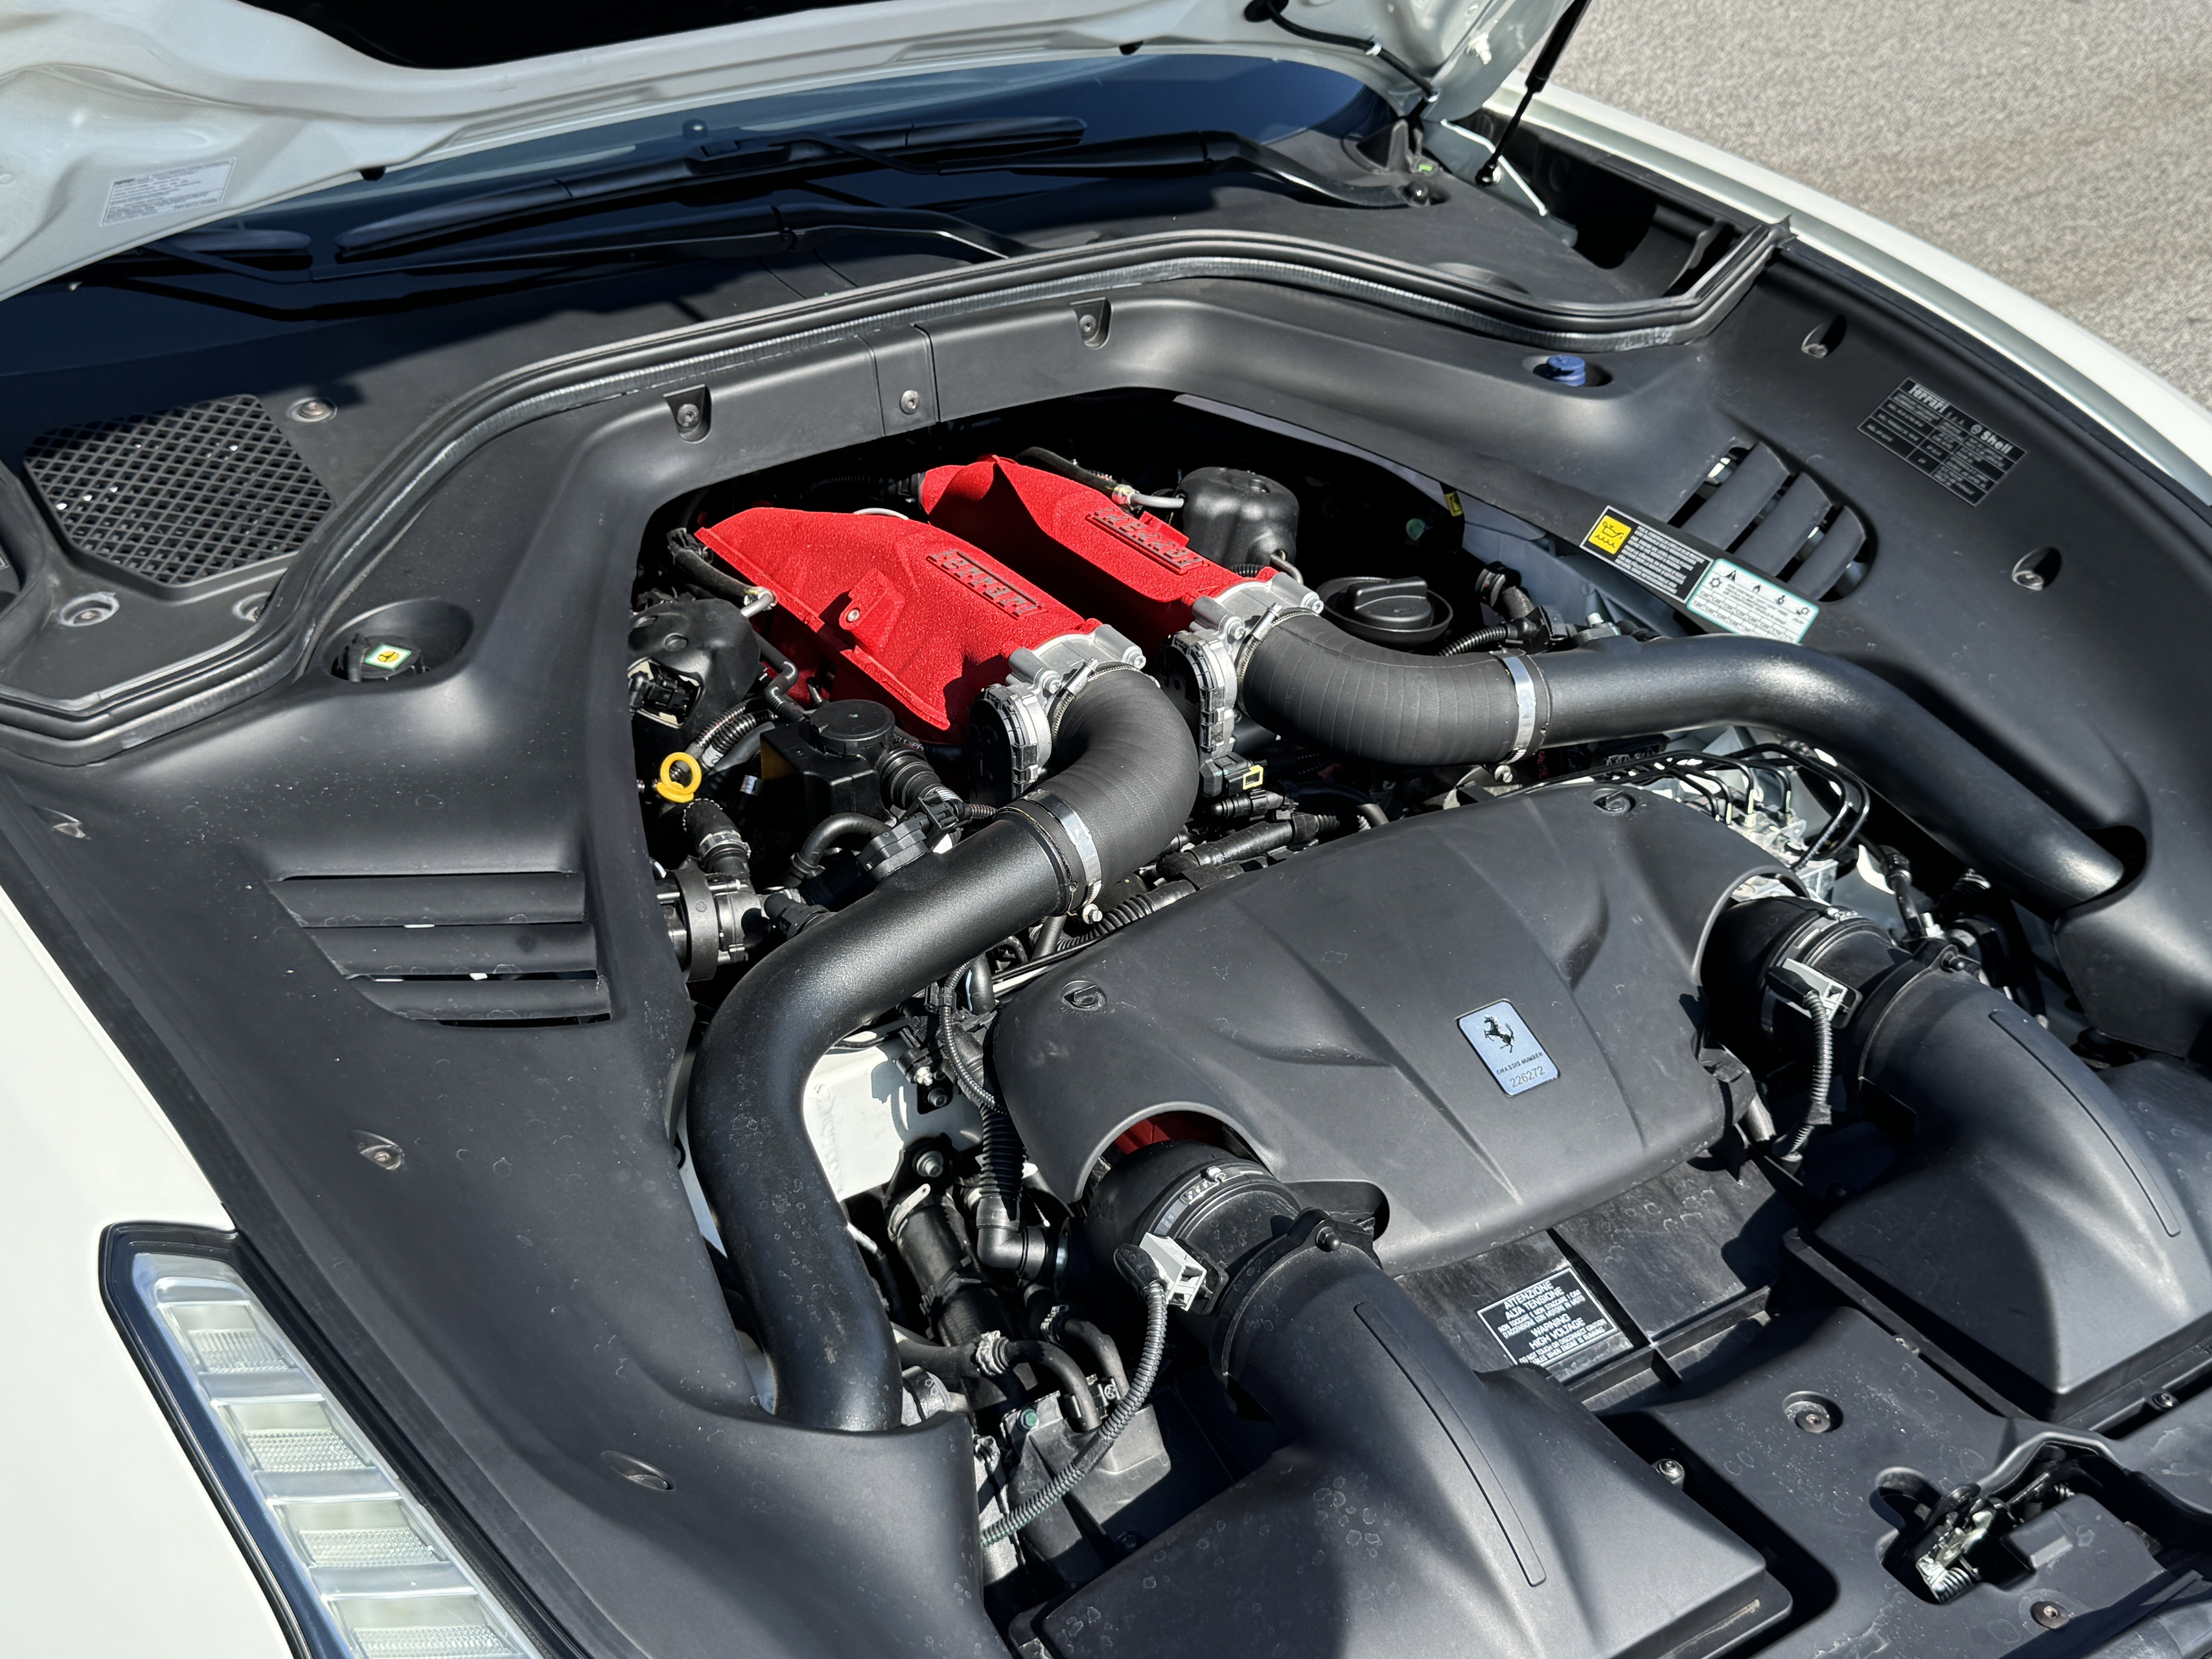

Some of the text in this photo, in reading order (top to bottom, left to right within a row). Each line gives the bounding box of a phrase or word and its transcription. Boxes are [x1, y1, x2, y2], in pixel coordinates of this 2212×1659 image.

[1908, 383, 1949, 414] Ferrari
[1979, 430, 2013, 455] Shell
[927, 548, 1044, 617] Ferrari
[1496, 1052, 1543, 1075] CHASSIS NUMBER
[1510, 1065, 1546, 1088] 226272
[1502, 1281, 1554, 1309] ATTENZIONE
[1503, 1286, 1565, 1319] ALTA TENSIONE
[1528, 1317, 1586, 1350] HIGH VOLTAGE
[1530, 1313, 1571, 1337] WARNING
